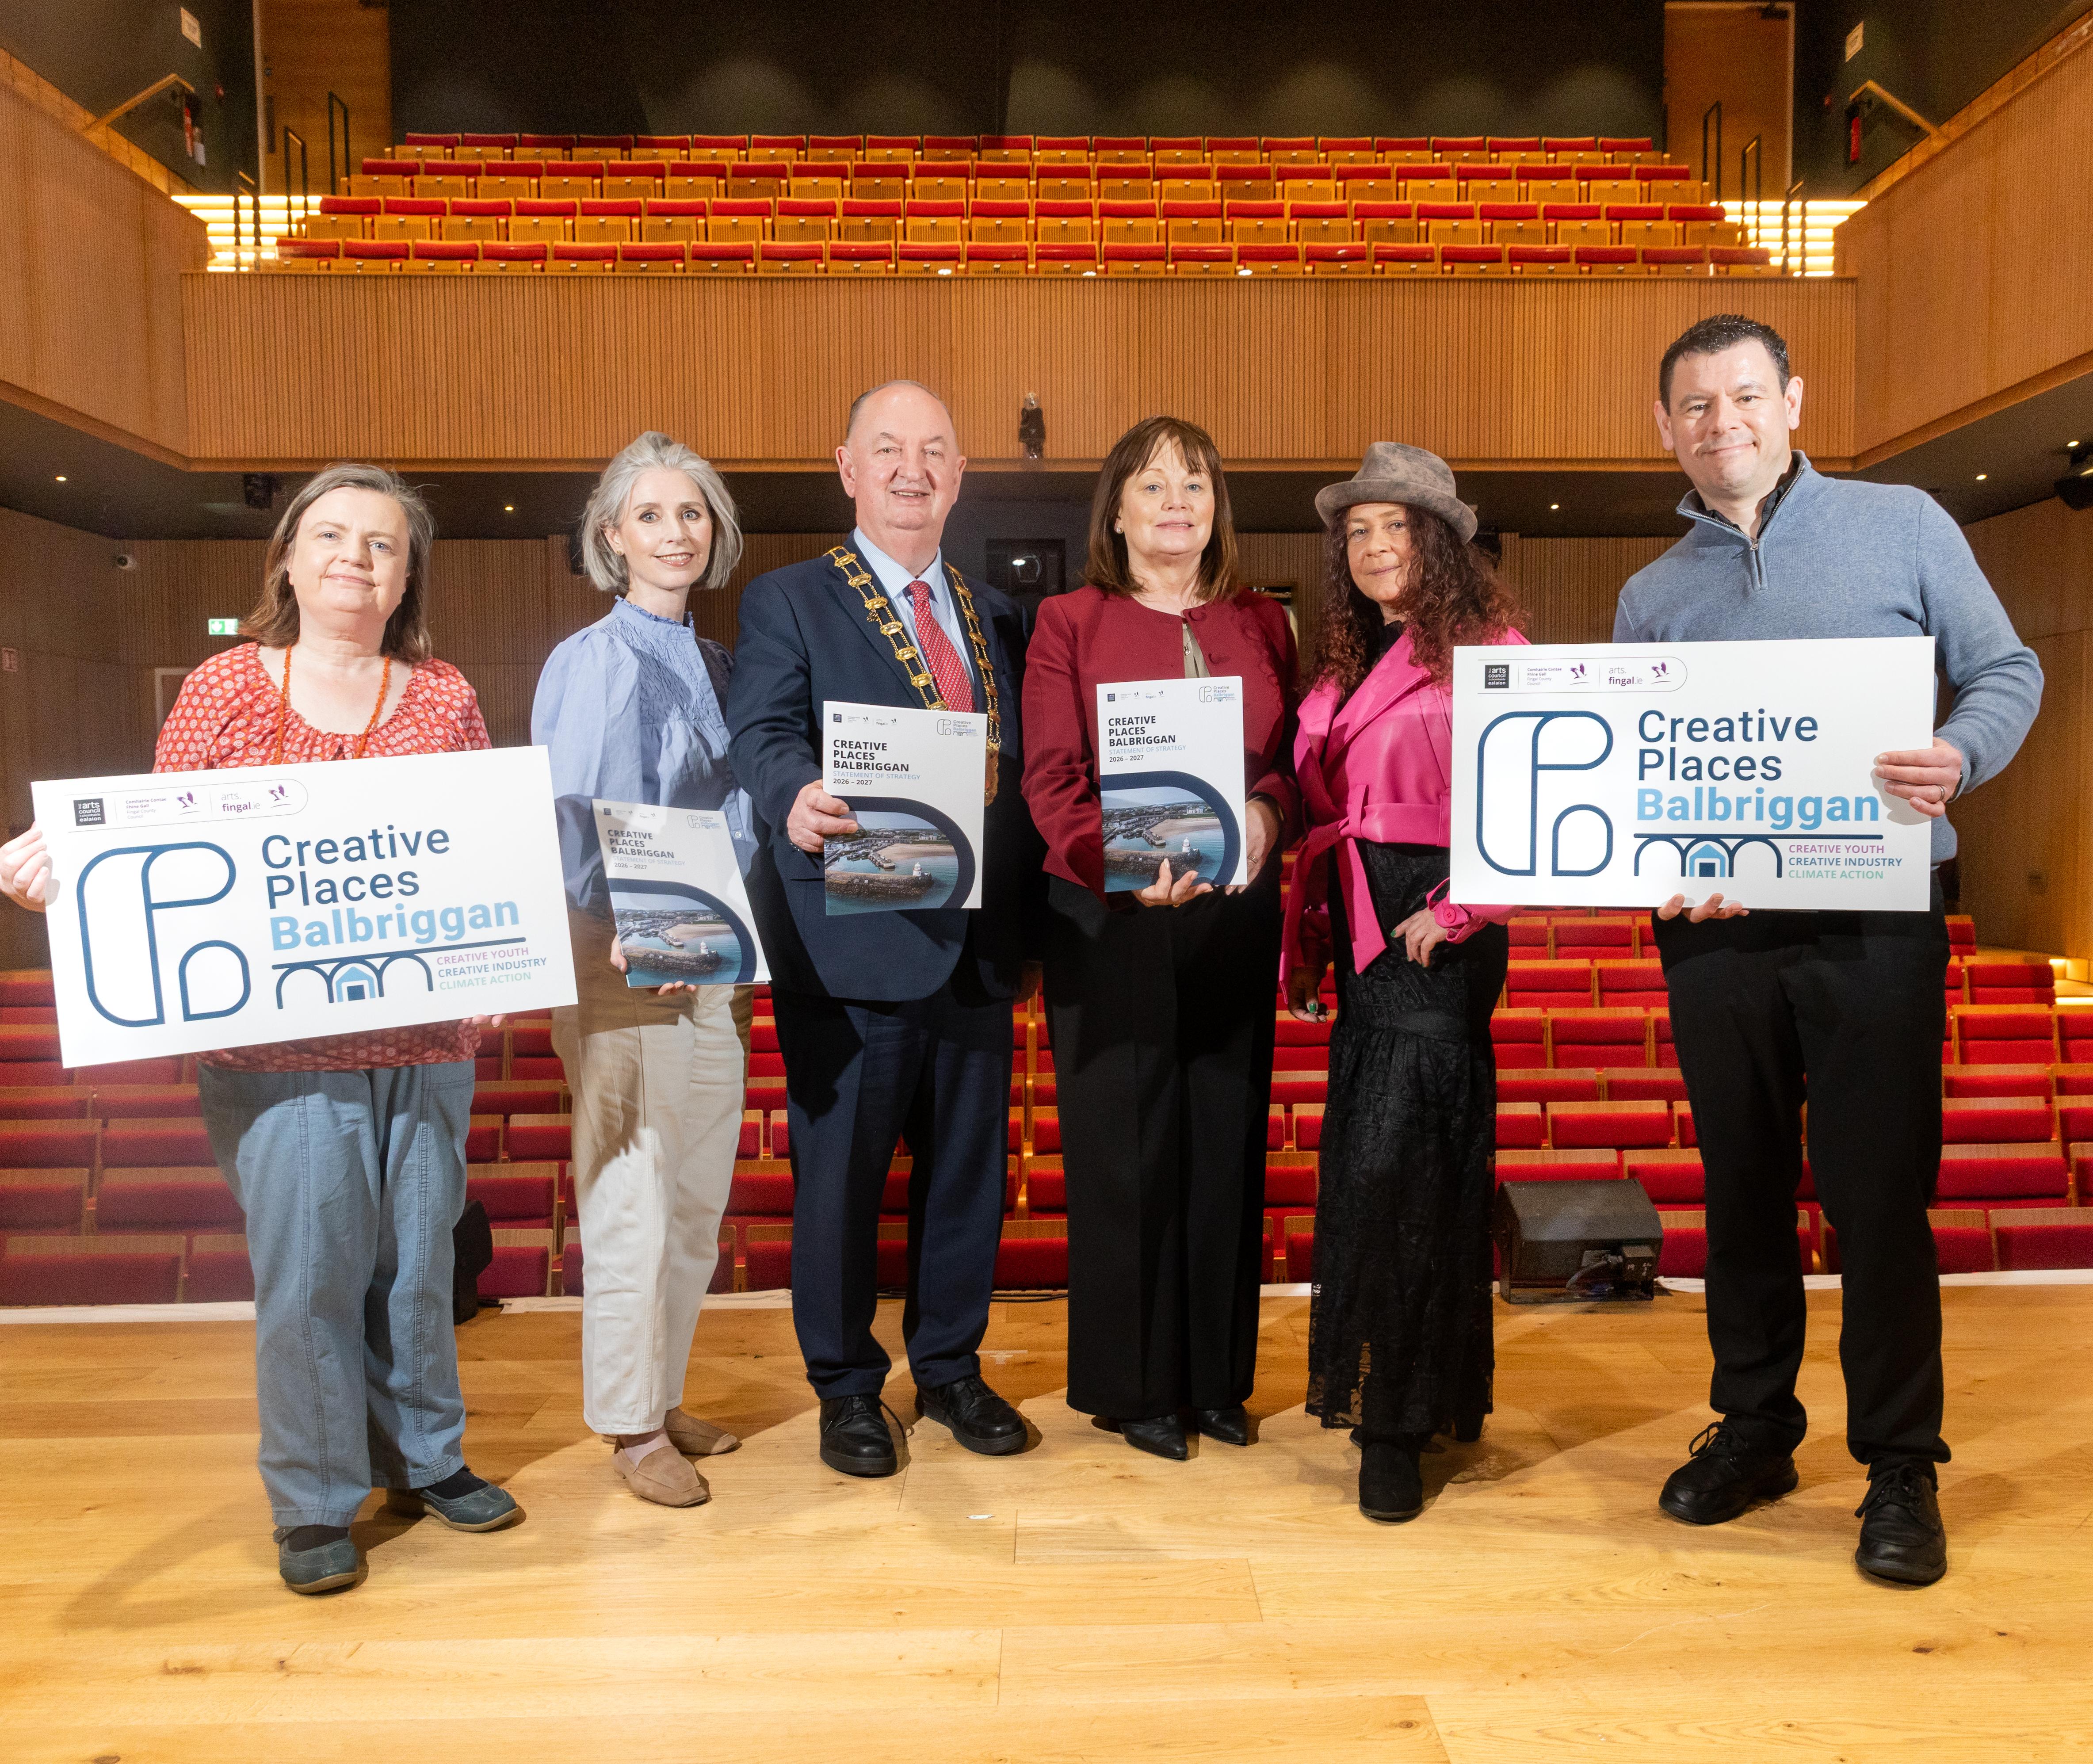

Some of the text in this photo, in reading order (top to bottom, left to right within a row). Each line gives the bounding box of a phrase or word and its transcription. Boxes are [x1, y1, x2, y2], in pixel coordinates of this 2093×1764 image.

[1608, 676, 1643, 687] fingal.ie
[1109, 716, 1155, 726] CREATIVE
[1639, 708, 1818, 742] Creative
[1109, 727, 1145, 736] PLACES
[834, 740, 886, 751] CREATIVE
[1110, 735, 1175, 746] BALBRIGGAN
[834, 750, 875, 760] PLACES
[834, 760, 909, 771] BALBRIGGAN
[1639, 747, 1781, 781] Places
[222, 802, 261, 813] fingal.ie
[1637, 787, 1879, 830] Balbriggan
[608, 829, 653, 840] CREATIVE
[262, 825, 449, 869] Creative
[610, 838, 645, 848] PLACES
[611, 847, 675, 859] BALBRIGGAN
[1789, 870, 1883, 879] CLIMATE ACTION
[267, 871, 419, 909] Places
[271, 901, 519, 951] Balbriggan
[437, 947, 528, 965] CREATIVE YOUTH
[439, 958, 546, 977] CREATIVE INDUSTRY
[439, 972, 531, 990] CLIMATE ACTION
